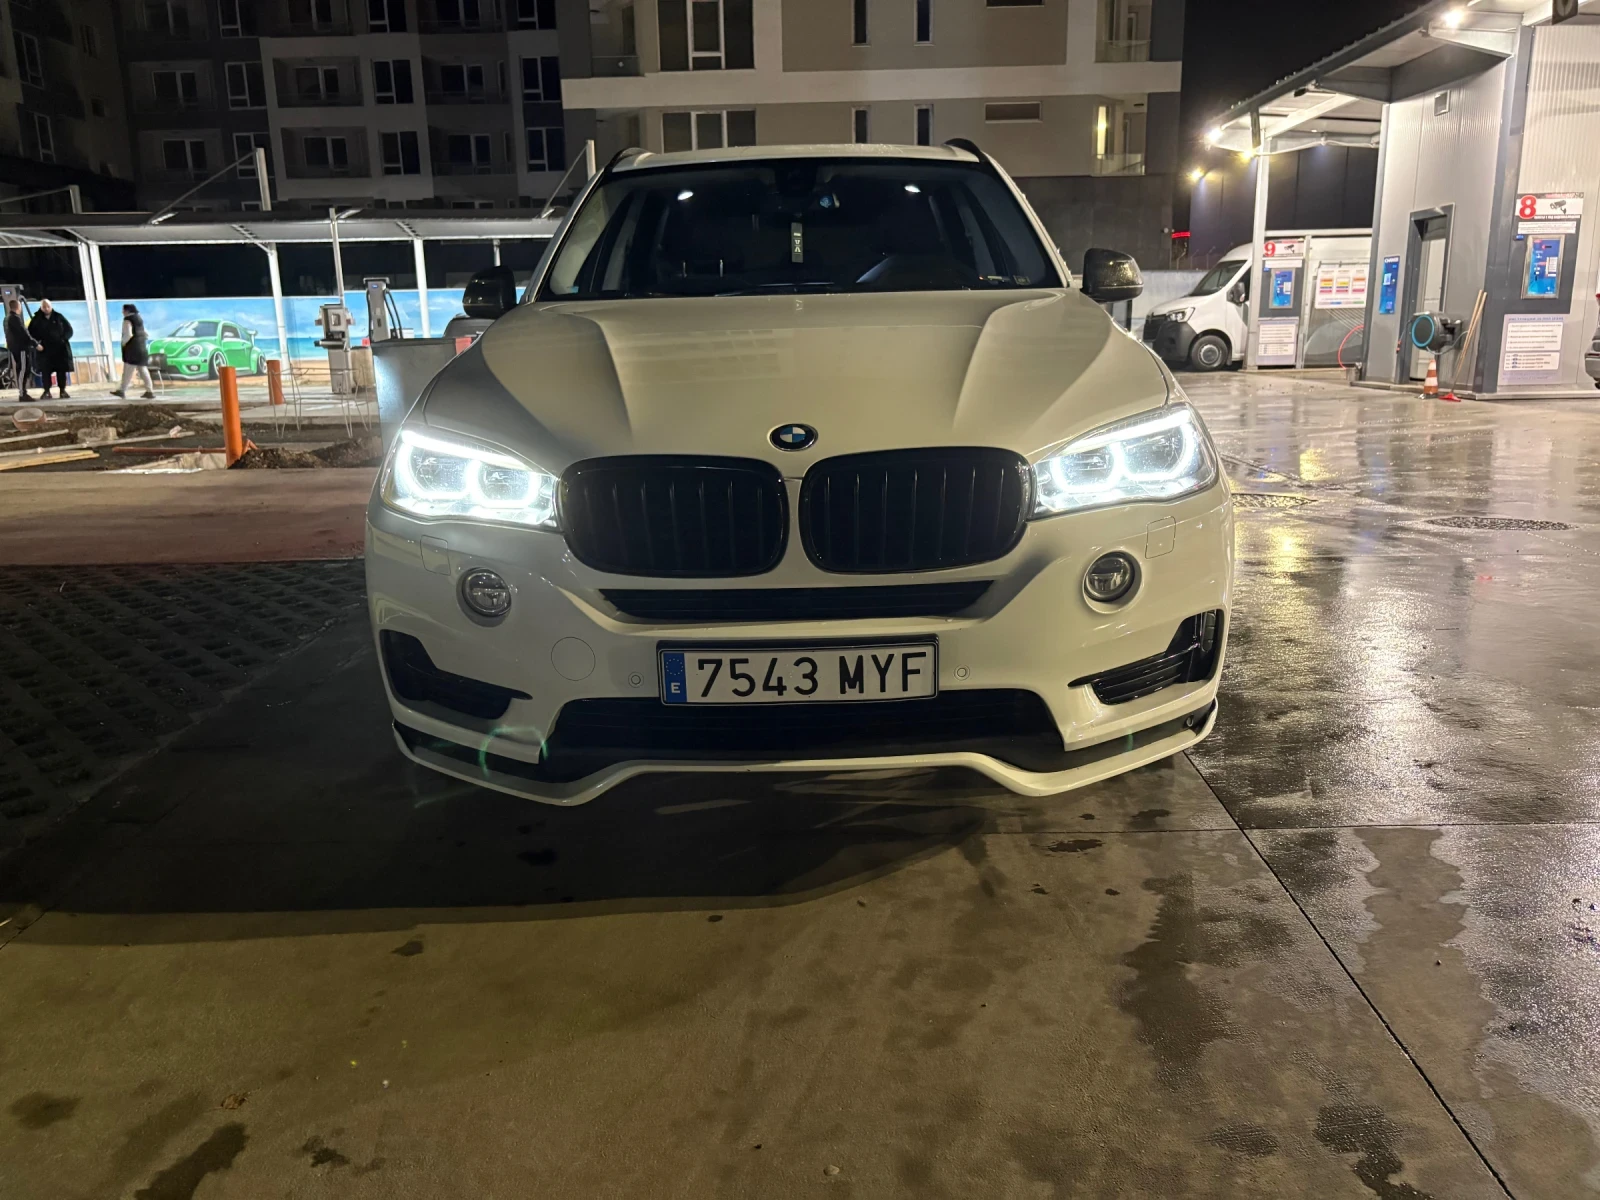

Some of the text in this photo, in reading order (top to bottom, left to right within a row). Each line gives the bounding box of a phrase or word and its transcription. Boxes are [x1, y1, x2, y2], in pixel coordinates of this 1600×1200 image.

[1519, 195, 1537, 219] 8
[1264, 241, 1276, 257] 9
[697, 651, 927, 698] 7543 MYF
[670, 682, 681, 694] E
